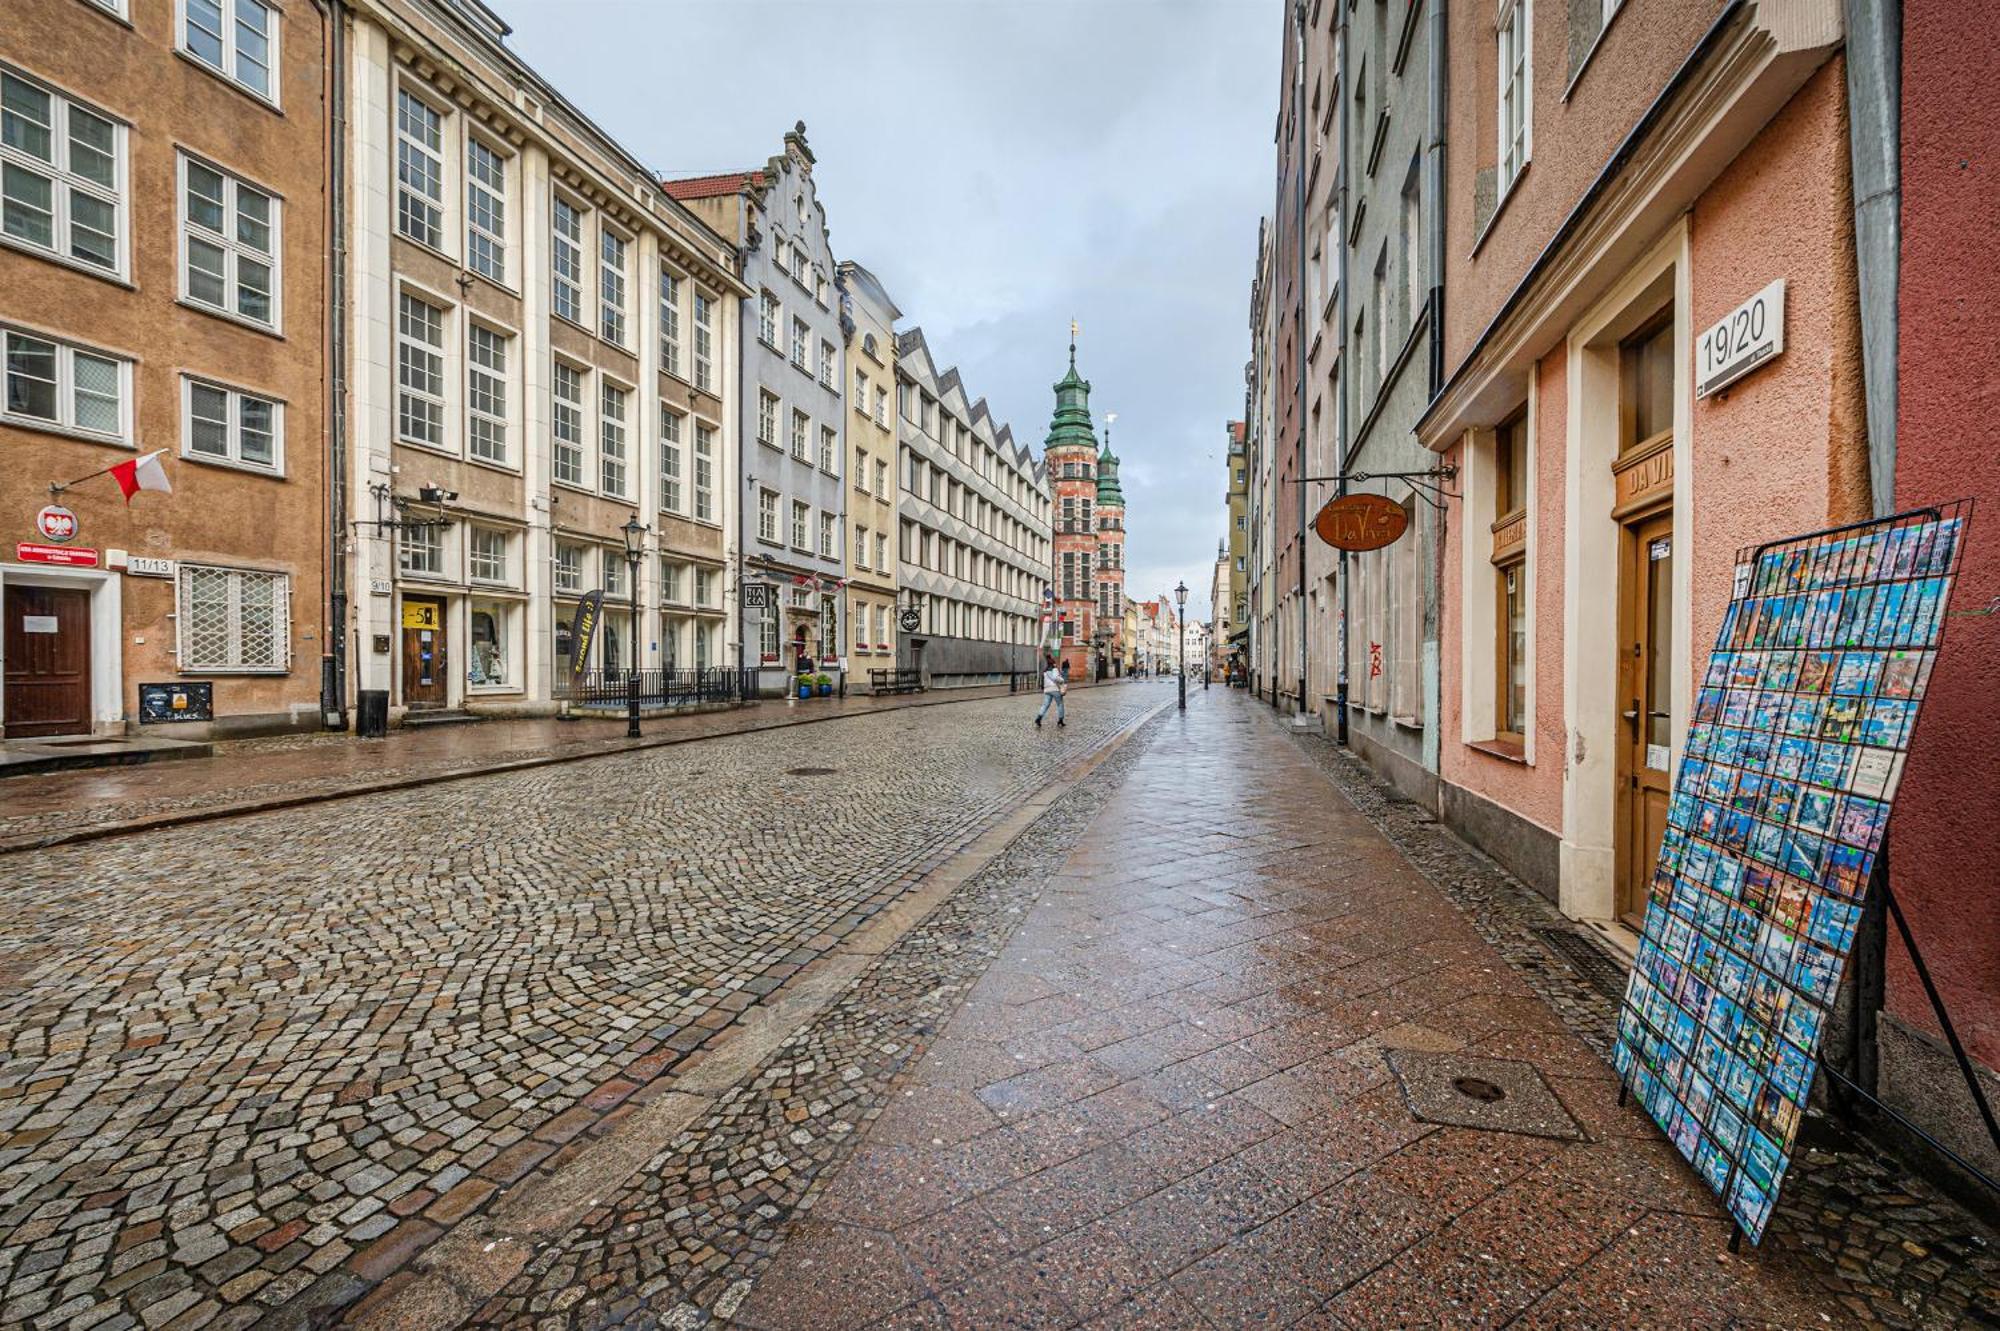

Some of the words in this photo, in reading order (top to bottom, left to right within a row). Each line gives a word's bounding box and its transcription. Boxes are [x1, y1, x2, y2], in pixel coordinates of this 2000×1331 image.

[1704, 298, 1765, 372] 19/20
[1630, 463, 1649, 496] DA
[134, 559, 169, 572] 11/13
